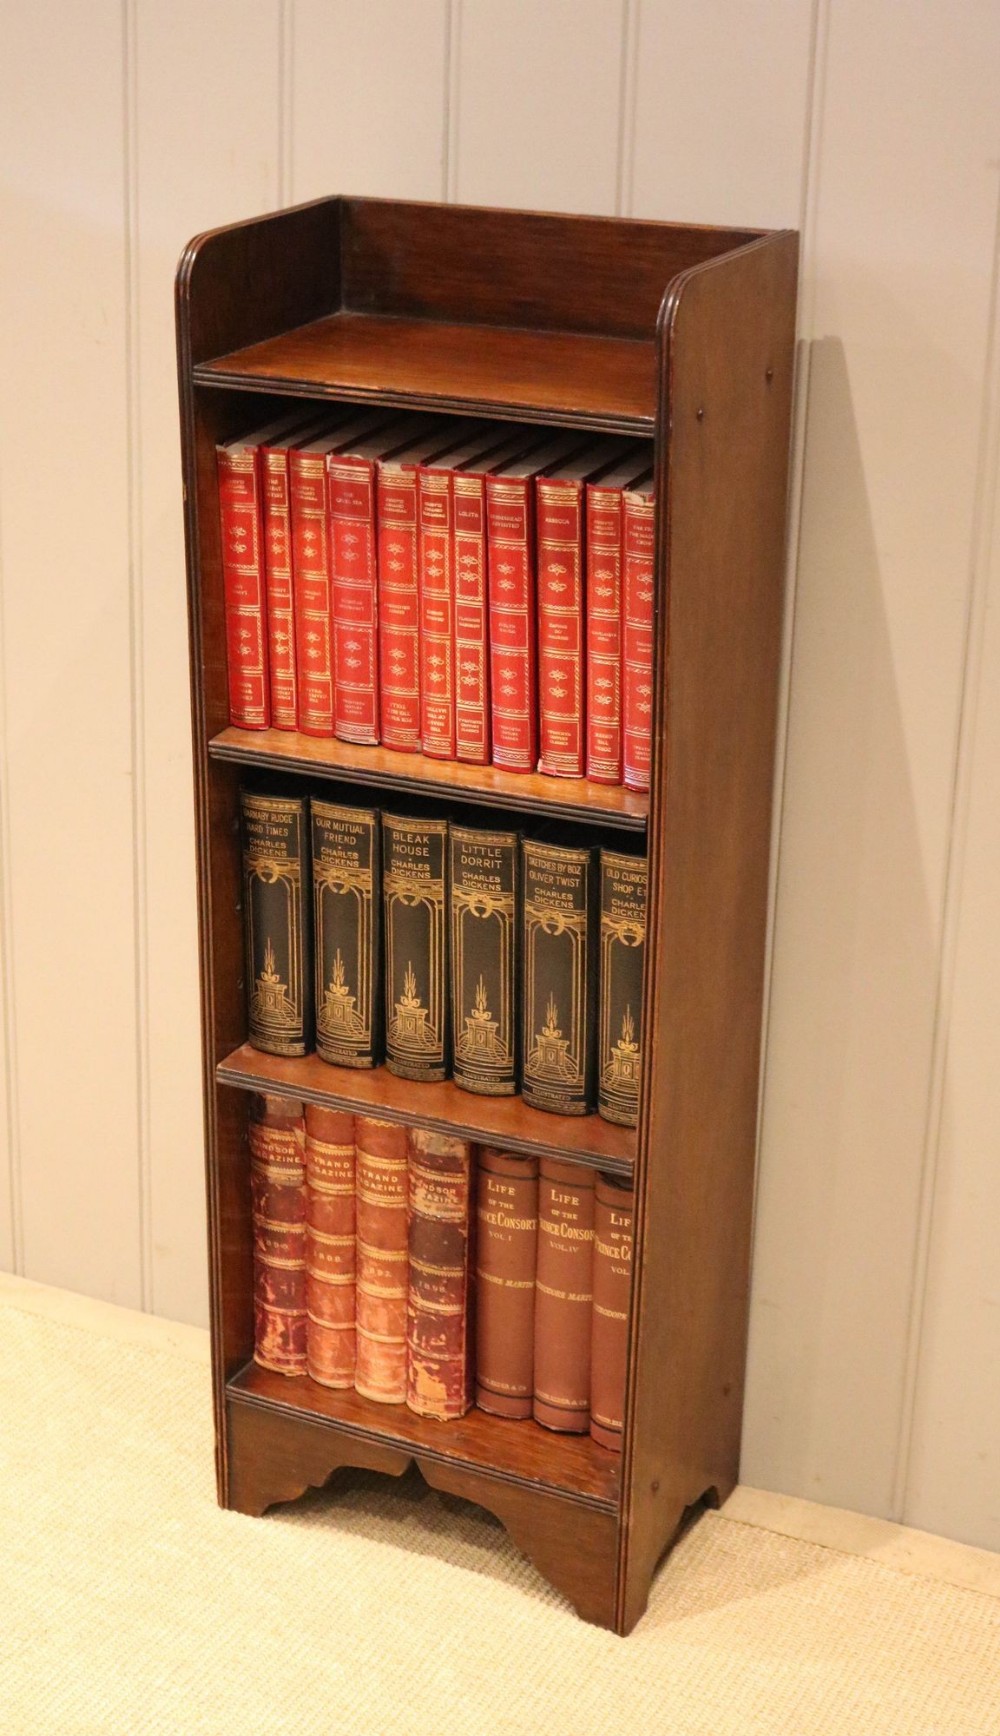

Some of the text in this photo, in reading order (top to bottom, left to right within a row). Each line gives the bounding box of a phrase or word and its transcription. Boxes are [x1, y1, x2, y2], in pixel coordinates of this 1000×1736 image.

[270, 813, 294, 824] RUDGE
[265, 823, 289, 837] TIMES
[316, 817, 365, 835] OUR MUTUAL
[250, 838, 287, 849] CHARLES
[324, 831, 357, 846] FRIEND
[392, 831, 430, 844] BLEAK
[250, 846, 288, 857] DICKENS
[320, 846, 359, 860] CHARLES
[392, 844, 430, 857] HOUSE
[462, 844, 502, 858] LITTLE
[321, 854, 360, 868] DICKENS
[390, 859, 431, 871] CHARLES
[461, 855, 502, 869] DORRIT
[391, 867, 431, 879] DICKENS
[567, 864, 582, 875] BOZ
[606, 868, 620, 880] OLD
[462, 871, 501, 883] CHARLES
[529, 870, 580, 888] OLIVER TWIST
[462, 880, 502, 892] DICKENS
[612, 882, 634, 895] SHOP
[534, 887, 574, 901] CHARLES
[534, 895, 574, 909] DICKENS
[487, 1179, 516, 1196] LIFE
[551, 1189, 580, 1206] LIFE
[498, 1201, 514, 1210] THE
[562, 1211, 578, 1220] THE
